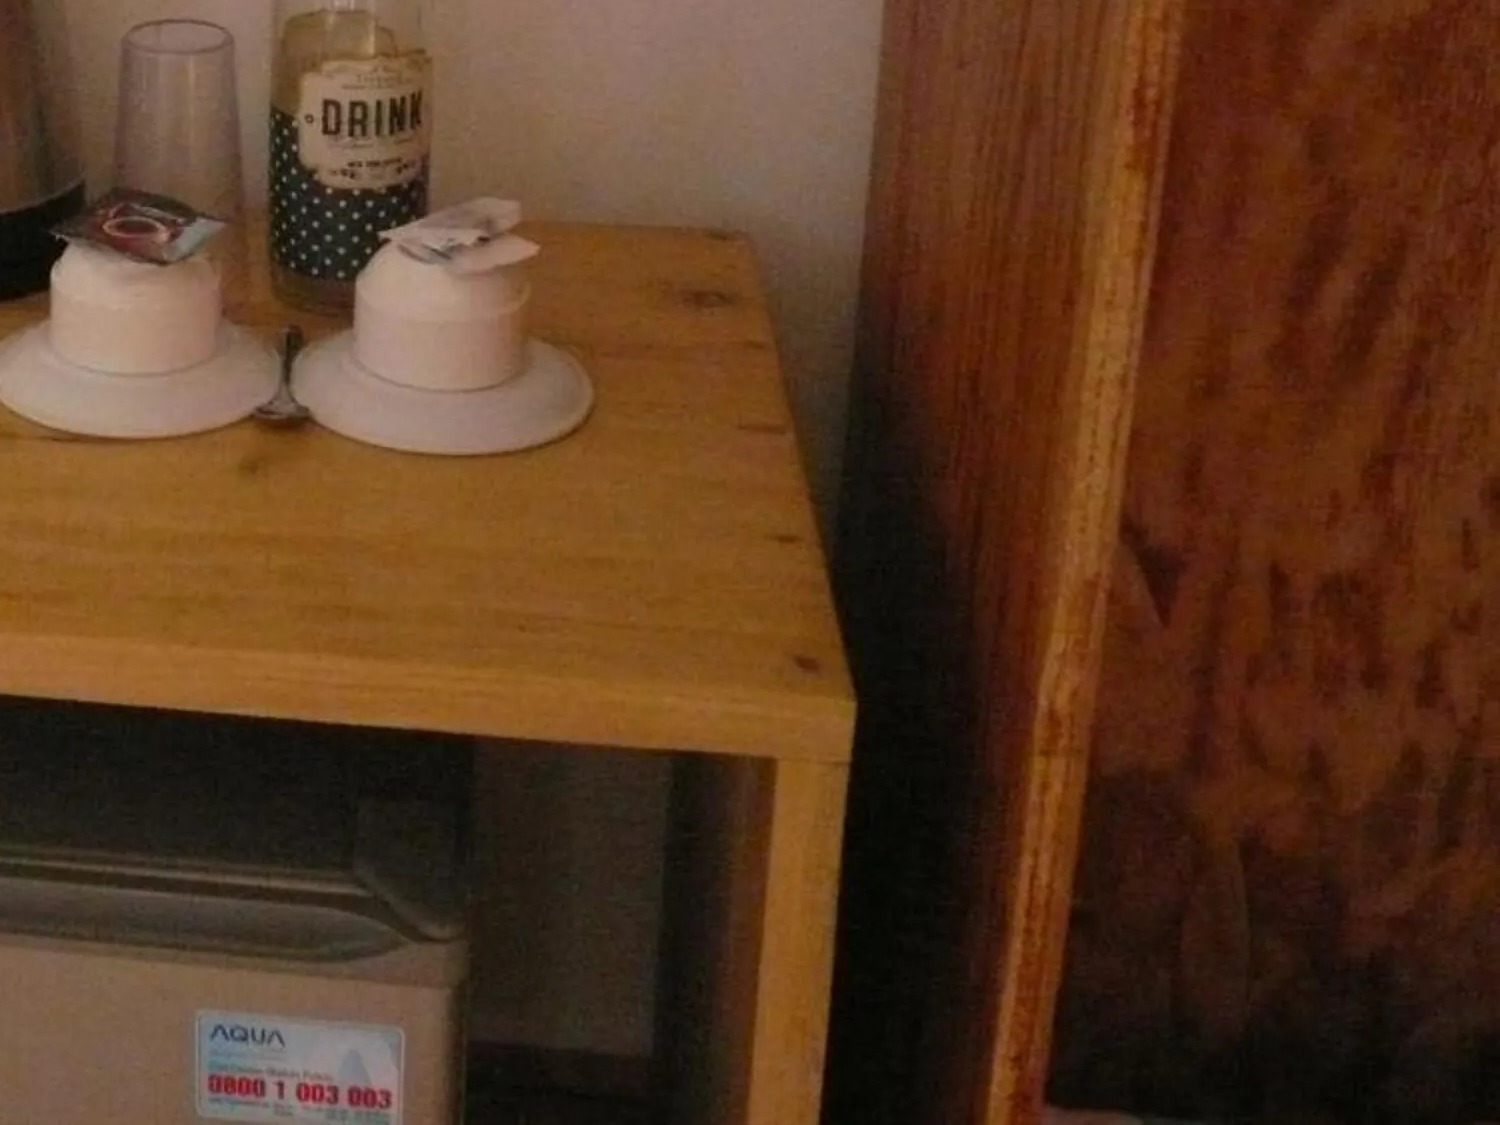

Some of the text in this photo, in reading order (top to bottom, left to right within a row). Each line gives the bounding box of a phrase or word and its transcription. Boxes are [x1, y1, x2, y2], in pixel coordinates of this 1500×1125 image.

[321, 89, 423, 137] DRINK
[210, 1023, 286, 1049] AQUA
[207, 1073, 393, 1110] 0800 1 003 003
